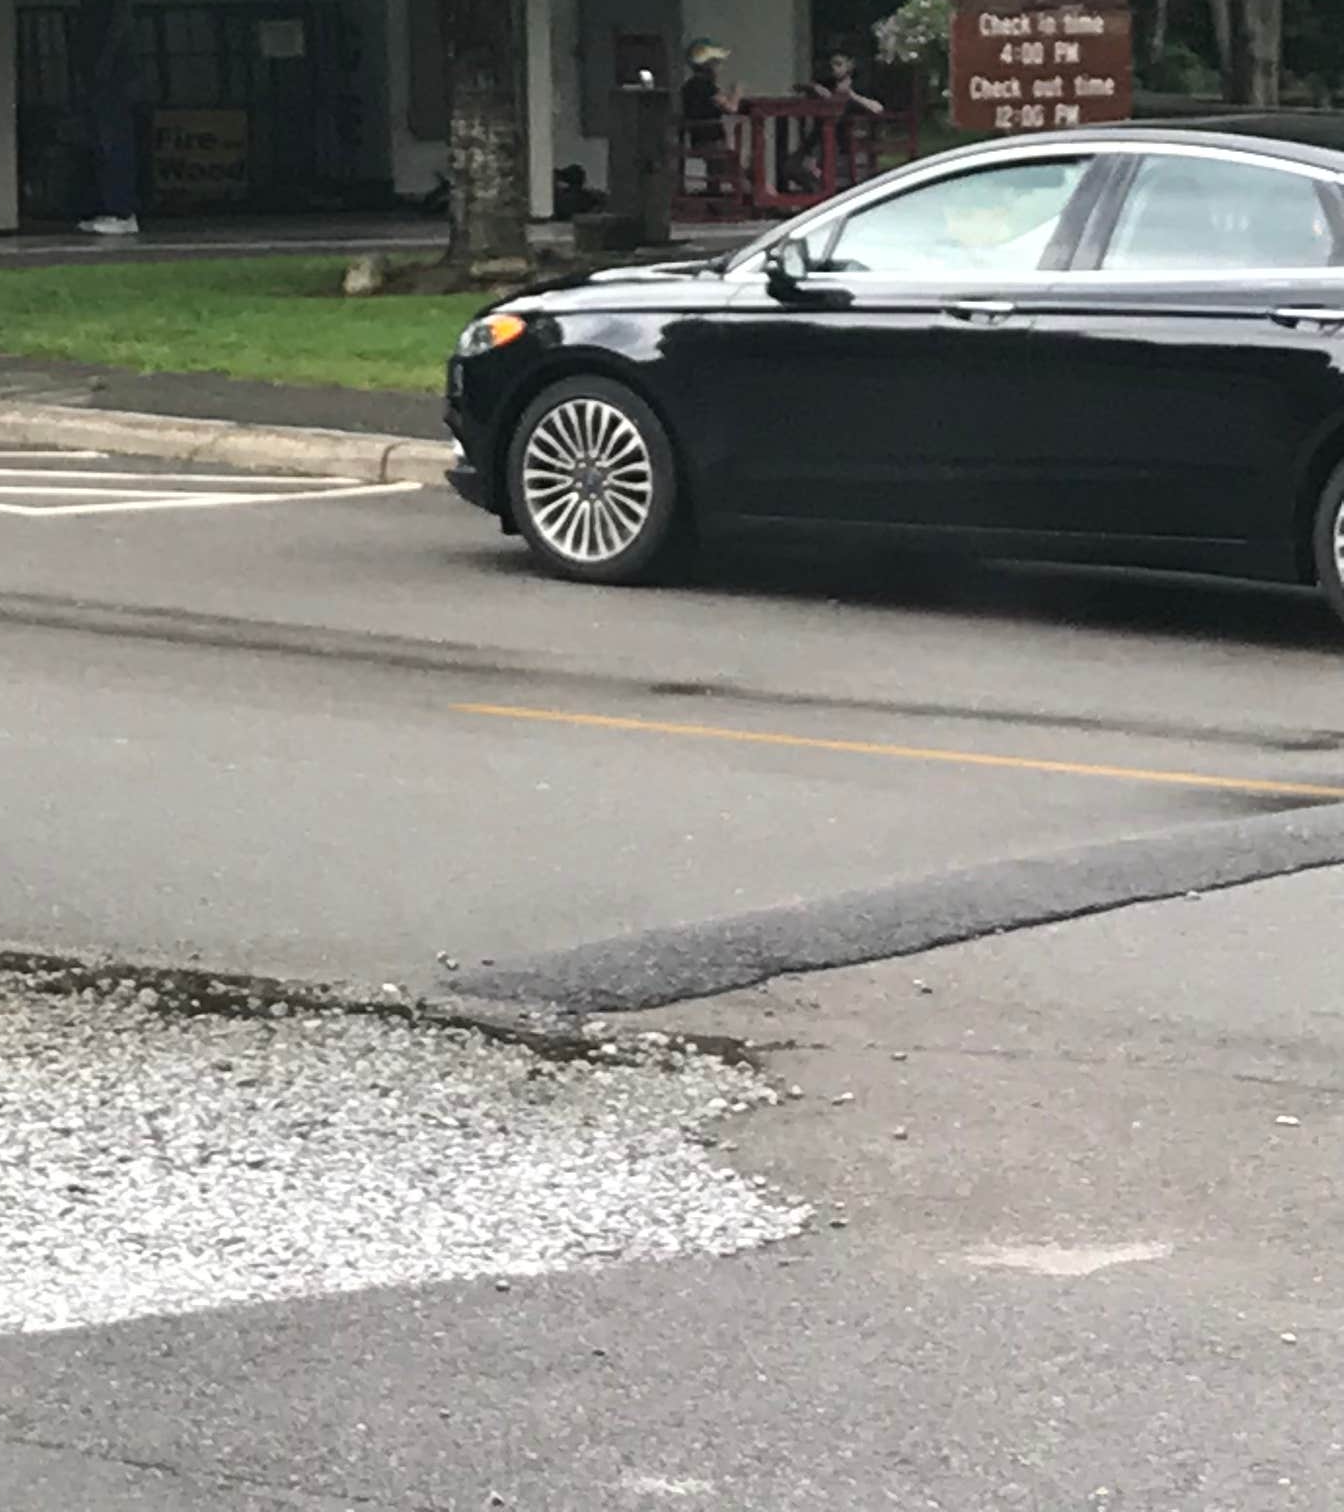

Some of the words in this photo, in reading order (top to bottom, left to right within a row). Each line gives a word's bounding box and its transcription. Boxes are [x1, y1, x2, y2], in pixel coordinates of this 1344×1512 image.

[978, 12, 1031, 36] Check
[999, 41, 1044, 65] 4:00
[1053, 41, 1080, 64] PM
[969, 75, 1021, 100] Check
[1054, 103, 1080, 127] PM
